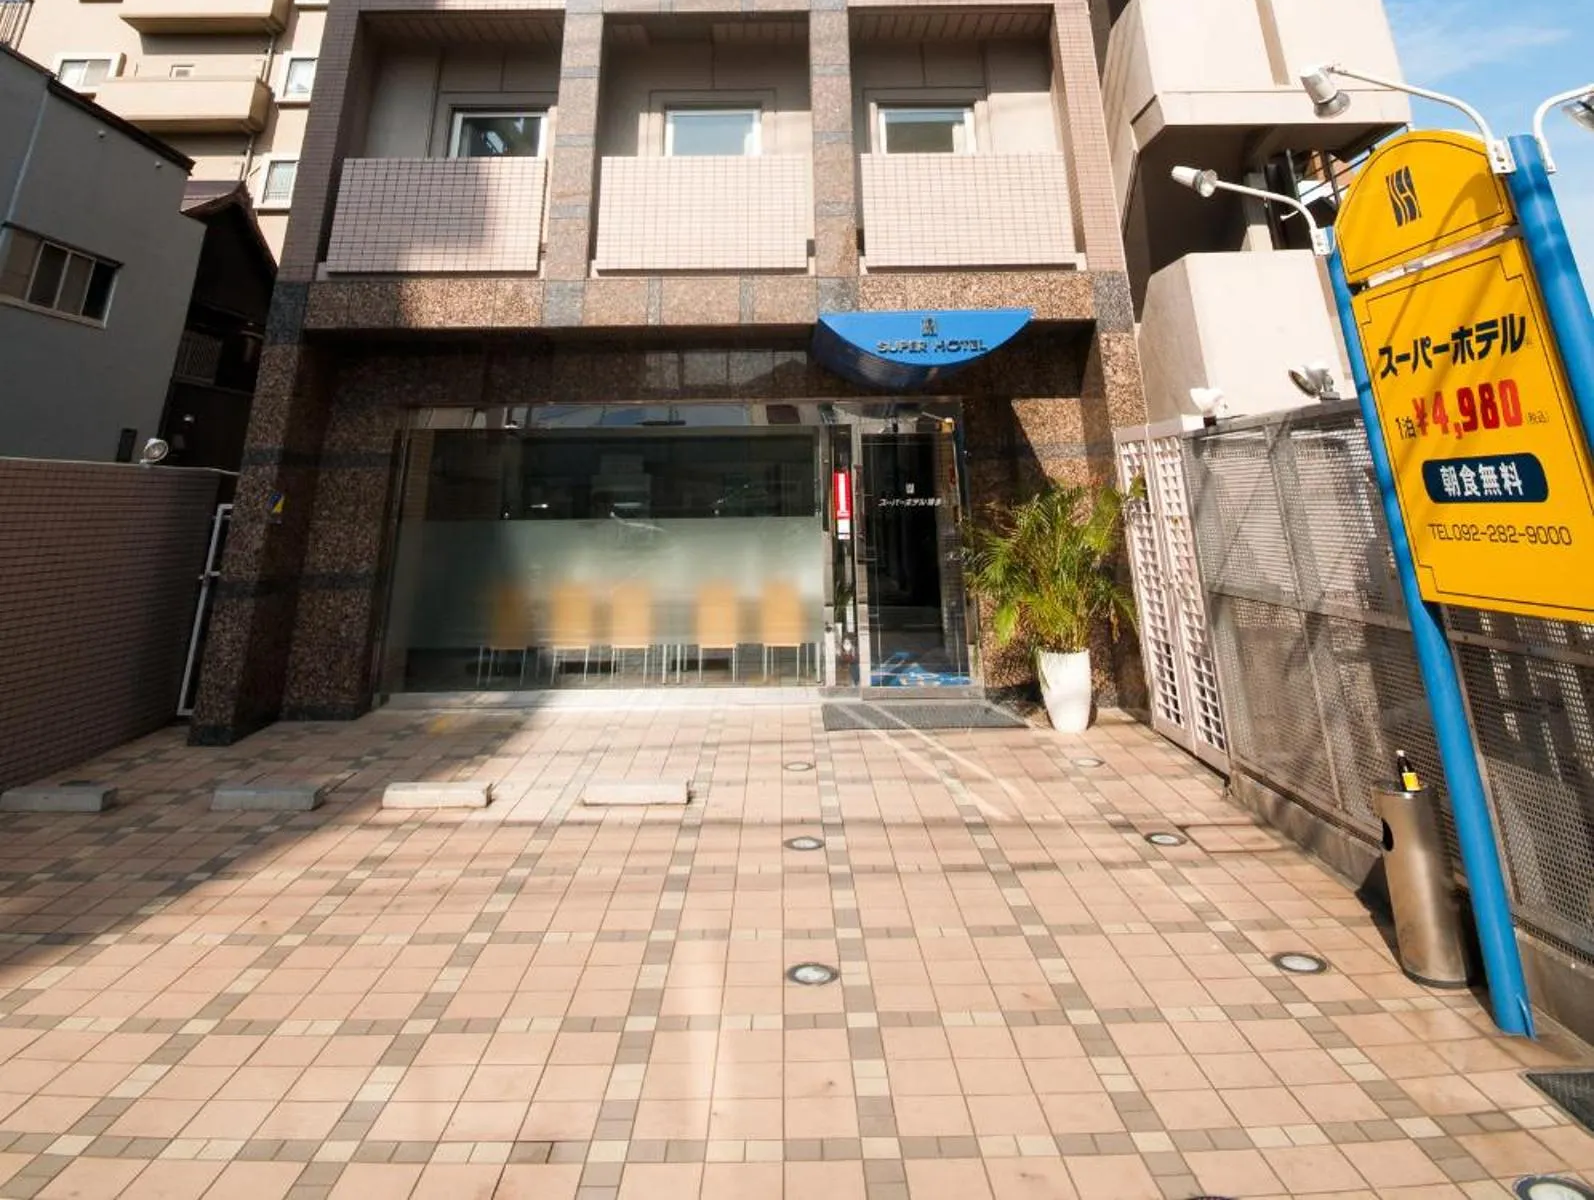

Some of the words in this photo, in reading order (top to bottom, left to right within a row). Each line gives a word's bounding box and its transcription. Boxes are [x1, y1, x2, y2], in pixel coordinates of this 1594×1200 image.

[877, 339, 928, 353] SUPER
[935, 338, 988, 353] HOTEL
[1378, 313, 1526, 380] スーパーホテル
[1412, 379, 1523, 440] ¥4,980
[1439, 461, 1524, 497] 朝食無料
